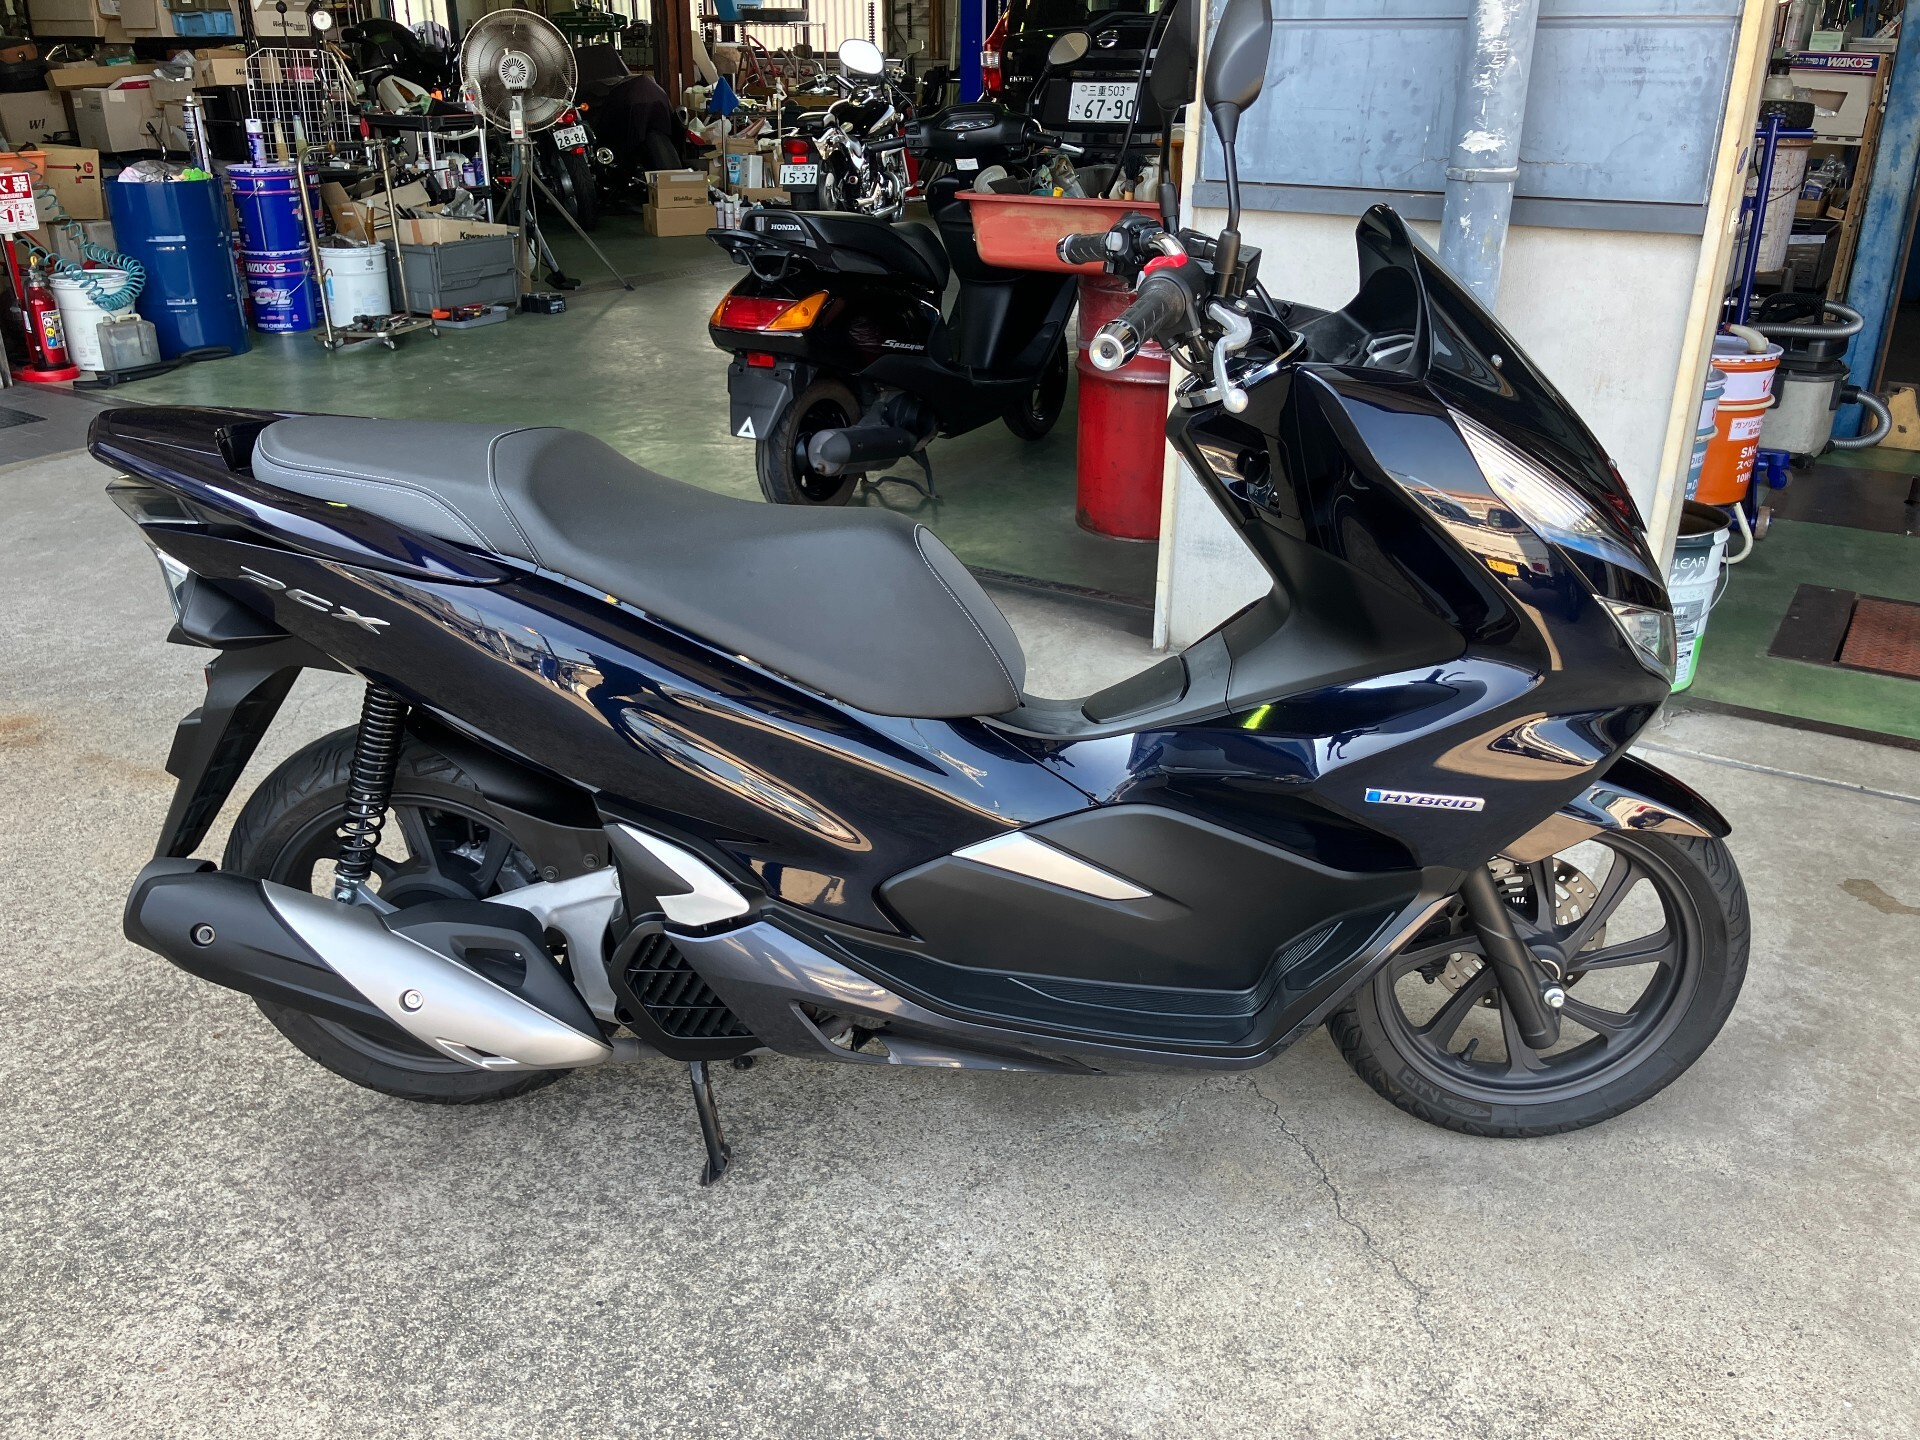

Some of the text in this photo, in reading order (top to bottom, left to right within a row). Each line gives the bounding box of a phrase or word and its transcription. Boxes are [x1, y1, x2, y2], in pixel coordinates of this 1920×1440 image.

[1084, 99, 1134, 120] 67-90
[557, 132, 586, 149] 28-86
[783, 172, 815, 184] 15-37
[770, 223, 801, 231] HONDA
[1736, 471, 1752, 483] 10W
[1671, 556, 1706, 570] LEAR
[1383, 793, 1477, 809] HYBRID
